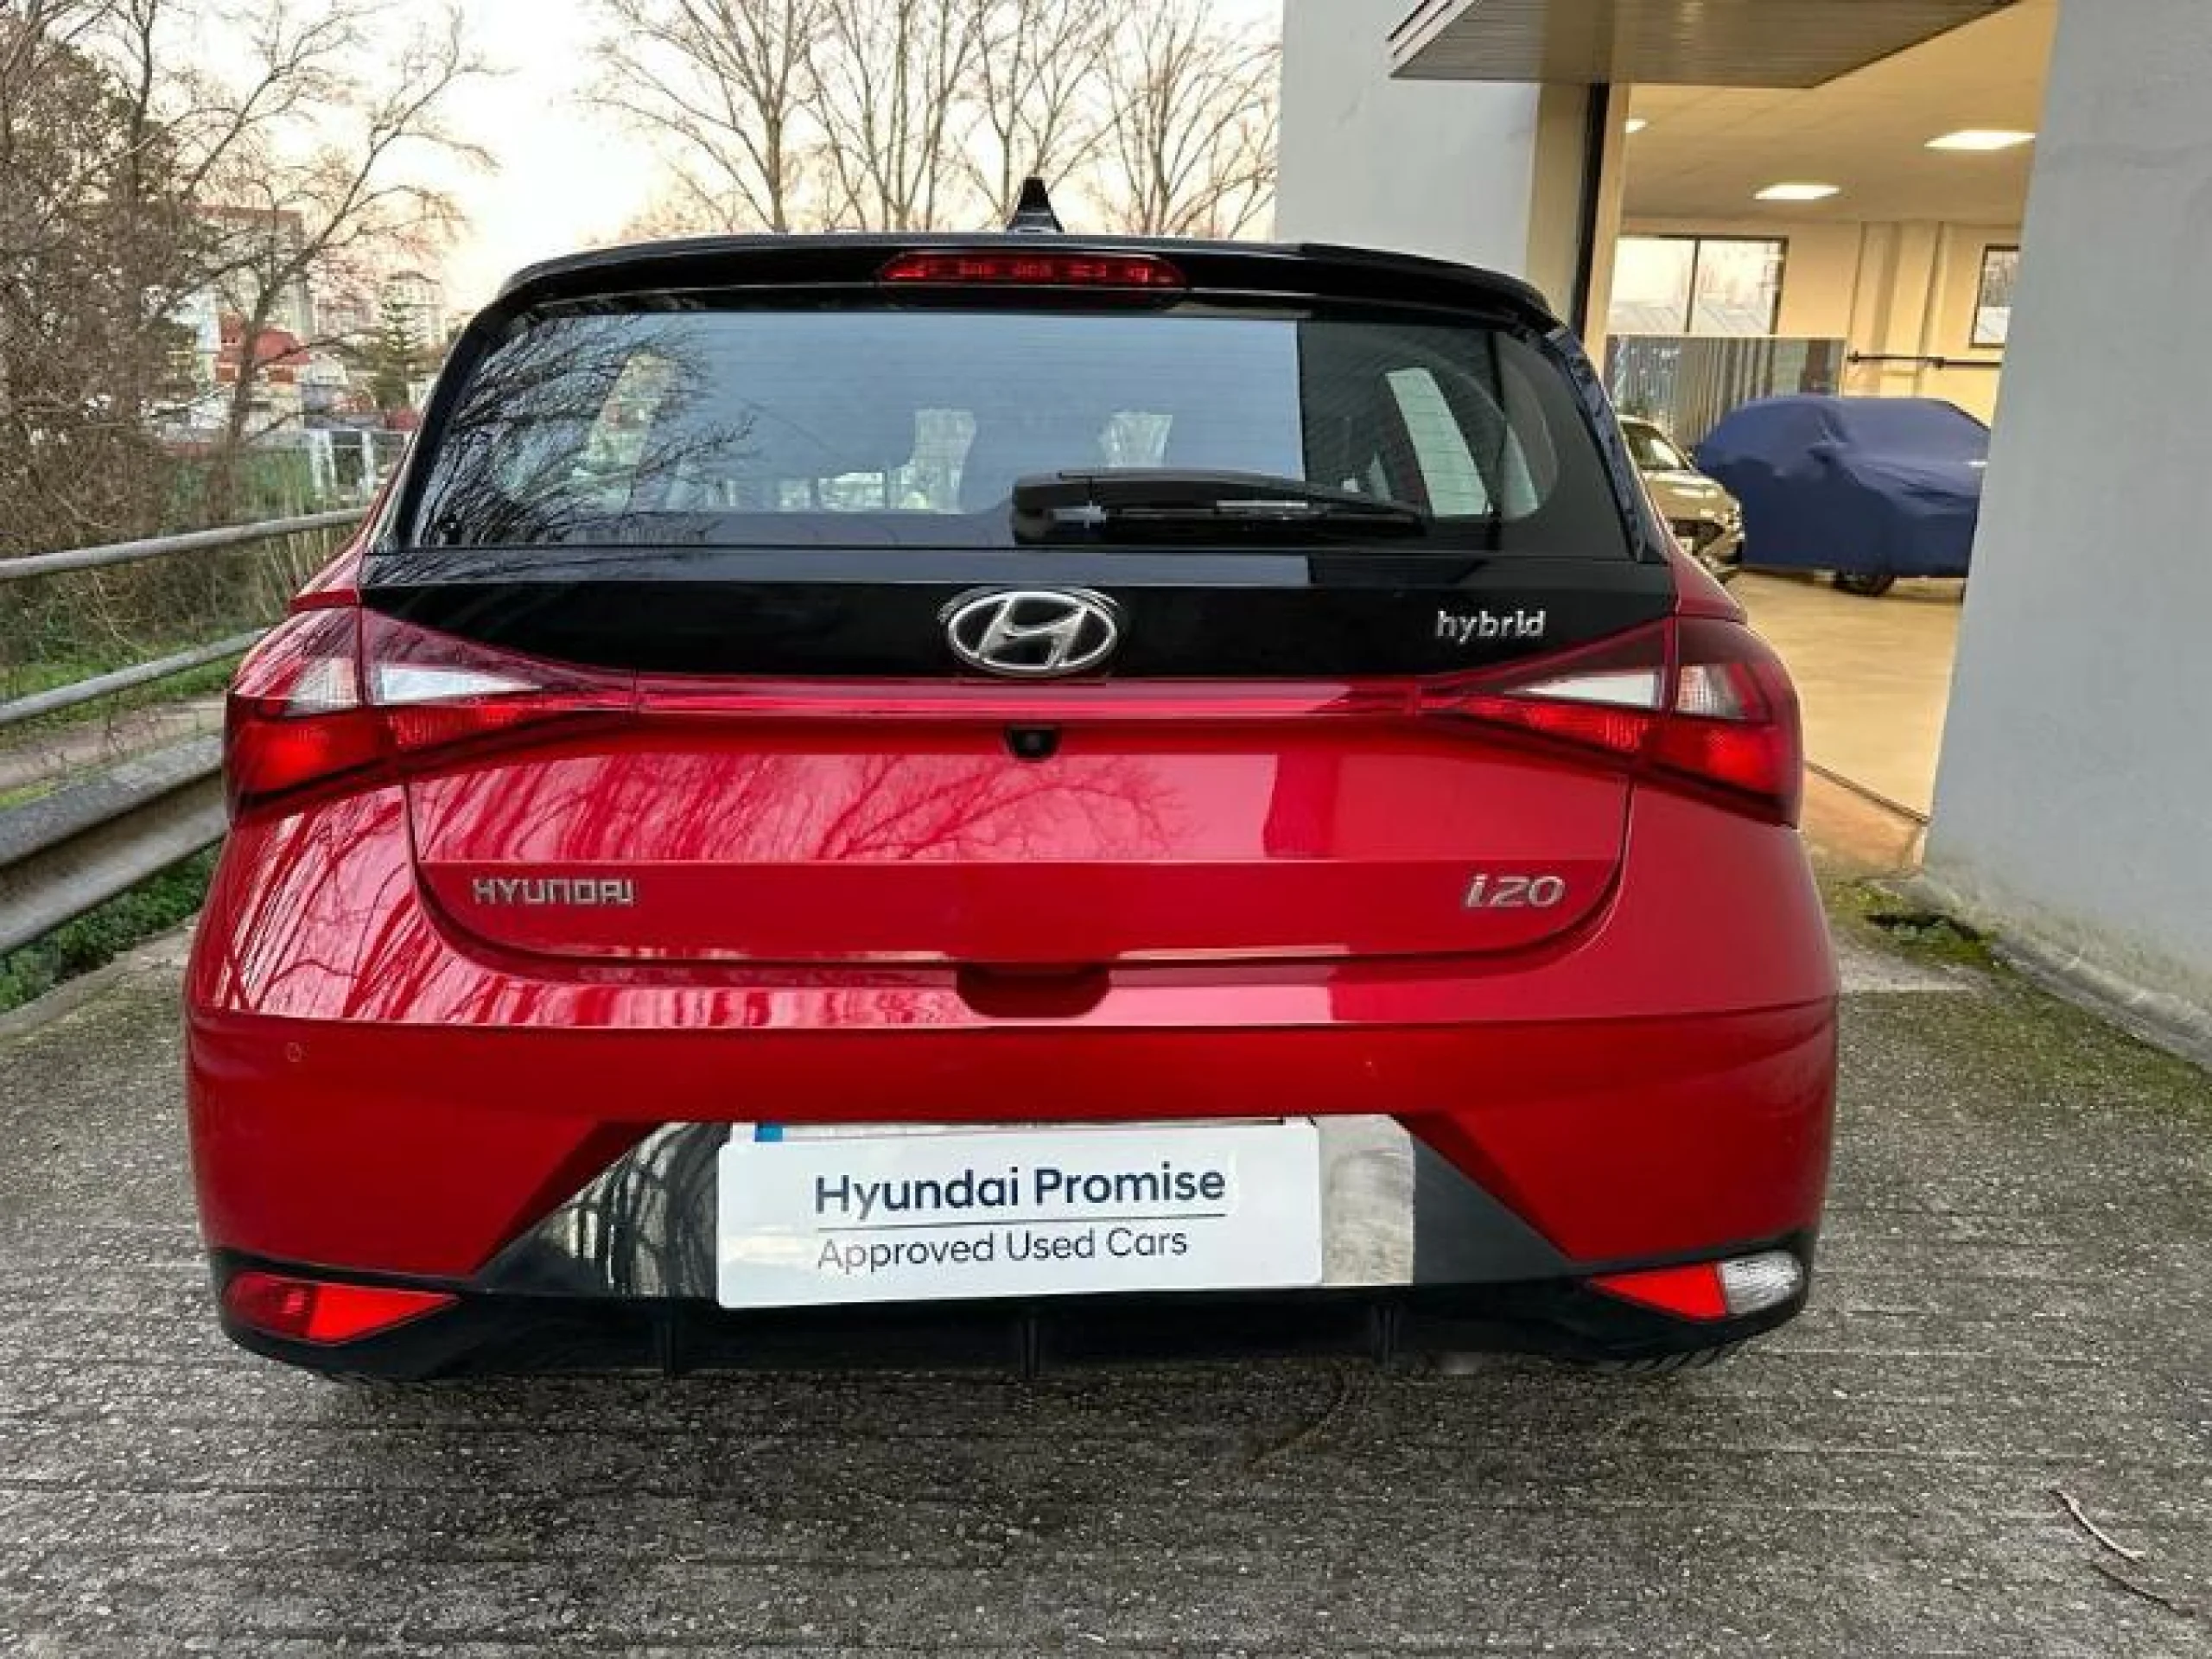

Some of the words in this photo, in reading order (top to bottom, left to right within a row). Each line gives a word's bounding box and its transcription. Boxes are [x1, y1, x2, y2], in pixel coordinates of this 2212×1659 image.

[1437, 610, 1547, 645] hybrid
[473, 879, 634, 906] HYUNDAI
[817, 1166, 1019, 1219] Hyundai
[1034, 1162, 1227, 1205] Promise
[817, 1232, 994, 1274] Approved
[1006, 1230, 1096, 1262] Used
[1107, 1227, 1188, 1258] Cars
